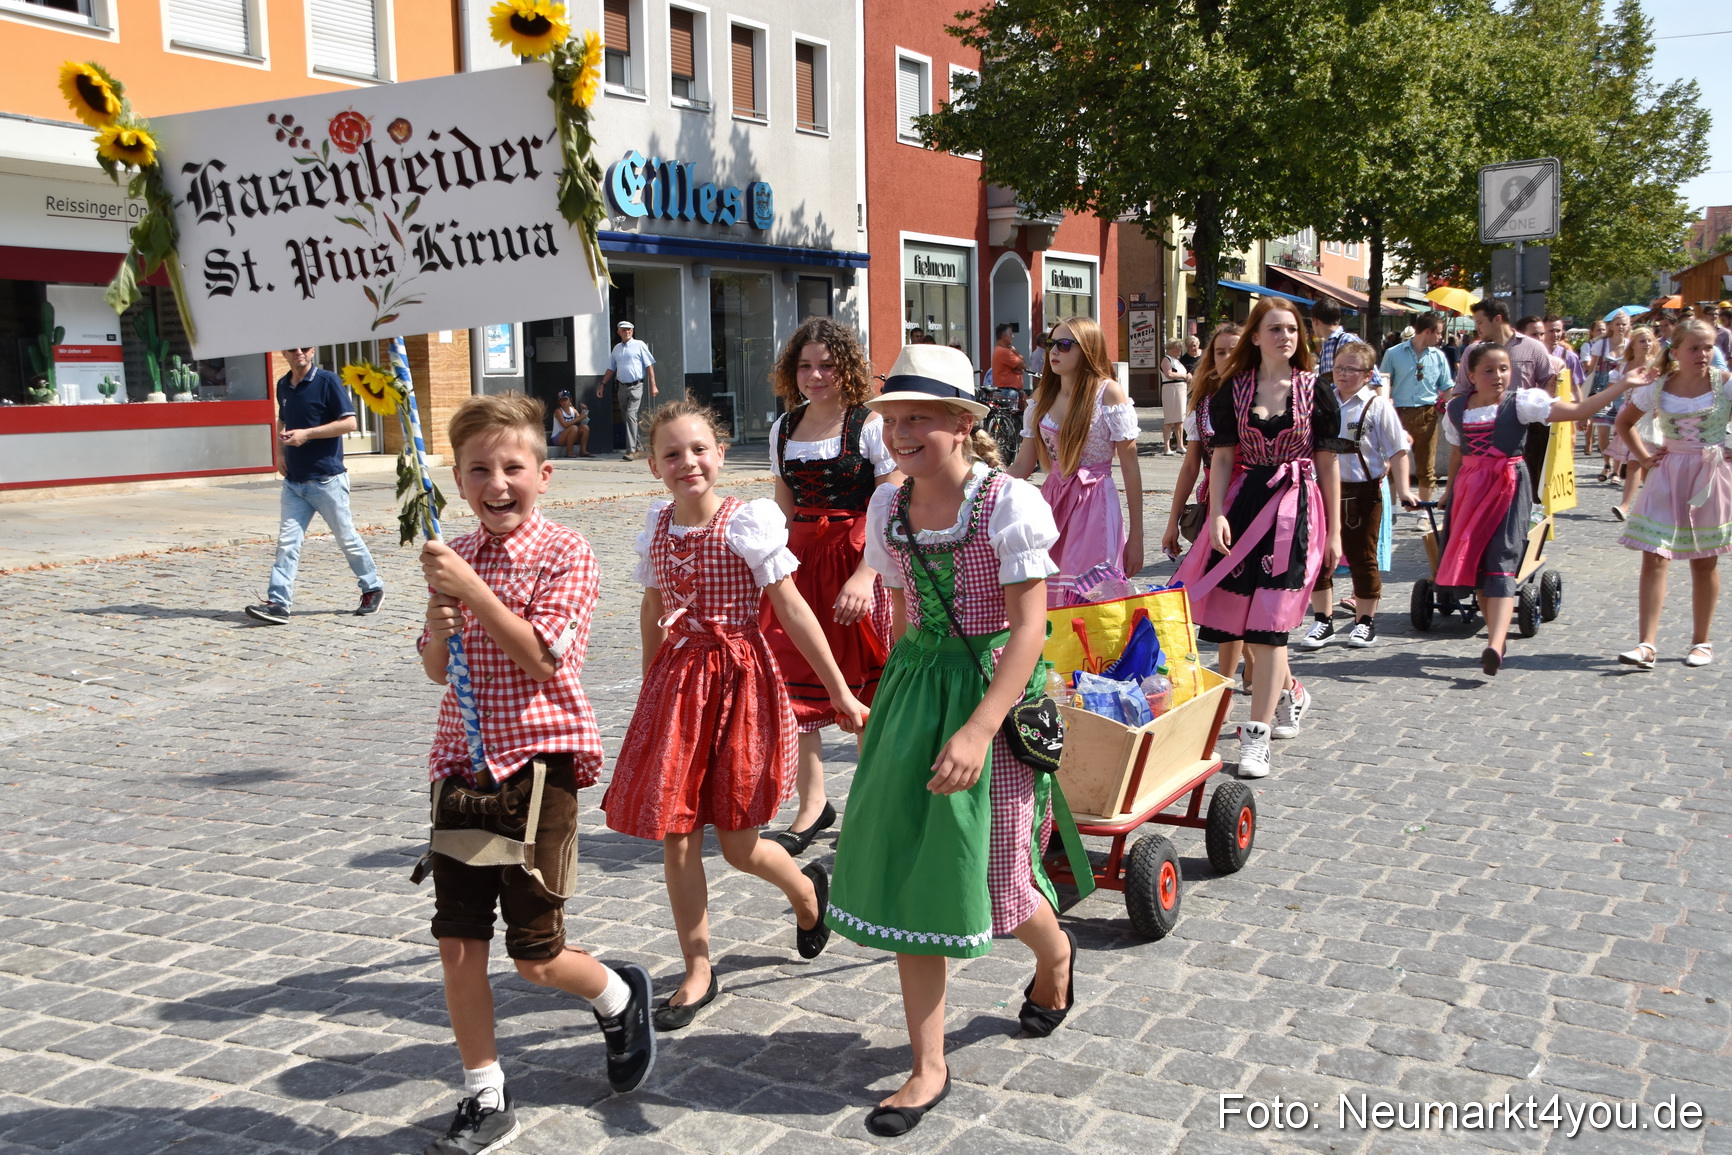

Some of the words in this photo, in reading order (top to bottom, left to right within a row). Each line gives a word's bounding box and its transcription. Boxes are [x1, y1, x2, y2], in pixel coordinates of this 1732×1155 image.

[182, 126, 544, 237] Hasenheider
[608, 150, 743, 227] Eilles
[46, 195, 123, 219] Reissinger
[1501, 217, 1536, 232] ZONE
[203, 248, 276, 300] St.
[285, 235, 397, 300] Pius
[407, 218, 560, 274] Kirwa
[914, 254, 956, 278] fielmann
[1051, 269, 1083, 290] fielmann
[1130, 327, 1155, 341] VENEZIA
[1552, 470, 1574, 500] 2015
